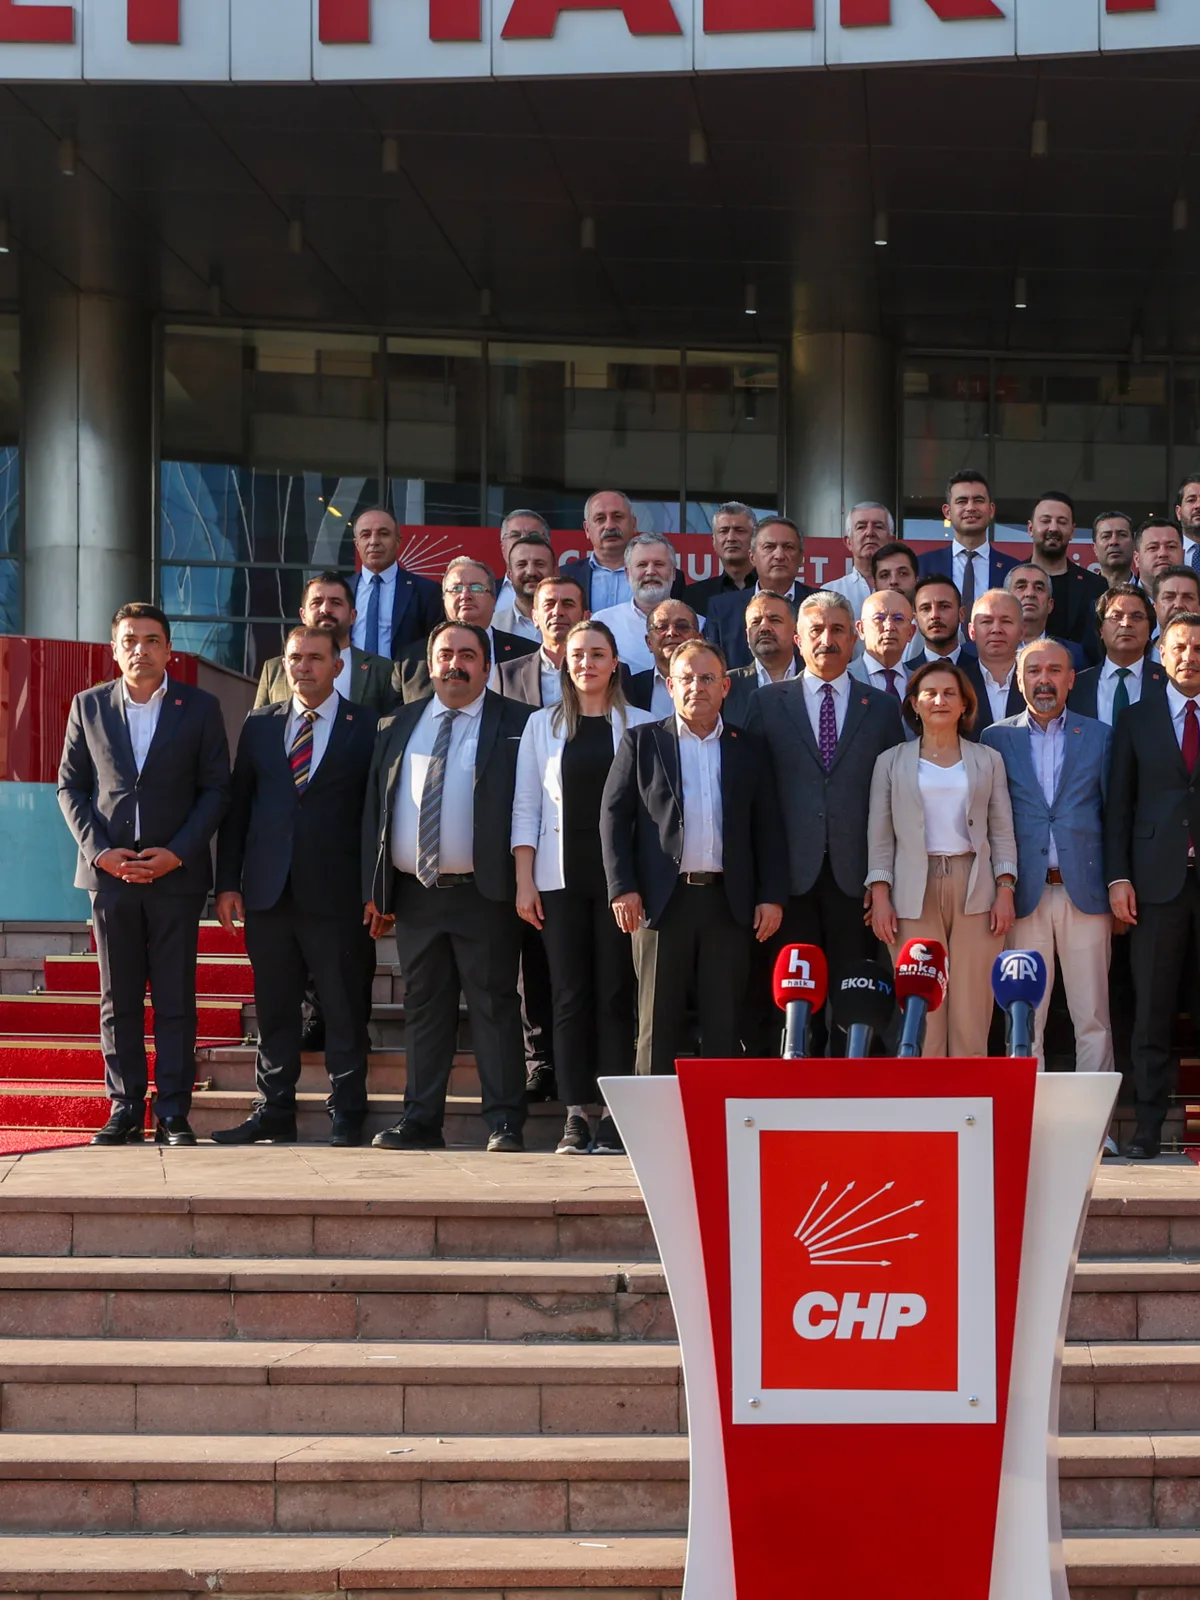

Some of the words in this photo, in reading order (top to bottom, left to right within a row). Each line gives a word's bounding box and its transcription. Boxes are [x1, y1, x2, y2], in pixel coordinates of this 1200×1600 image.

[788, 948, 810, 980] h
[899, 961, 937, 975] anka
[1000, 957, 1038, 982] AA
[841, 977, 876, 990] EKOL
[877, 980, 892, 995] TV
[792, 1290, 927, 1340] CHP
